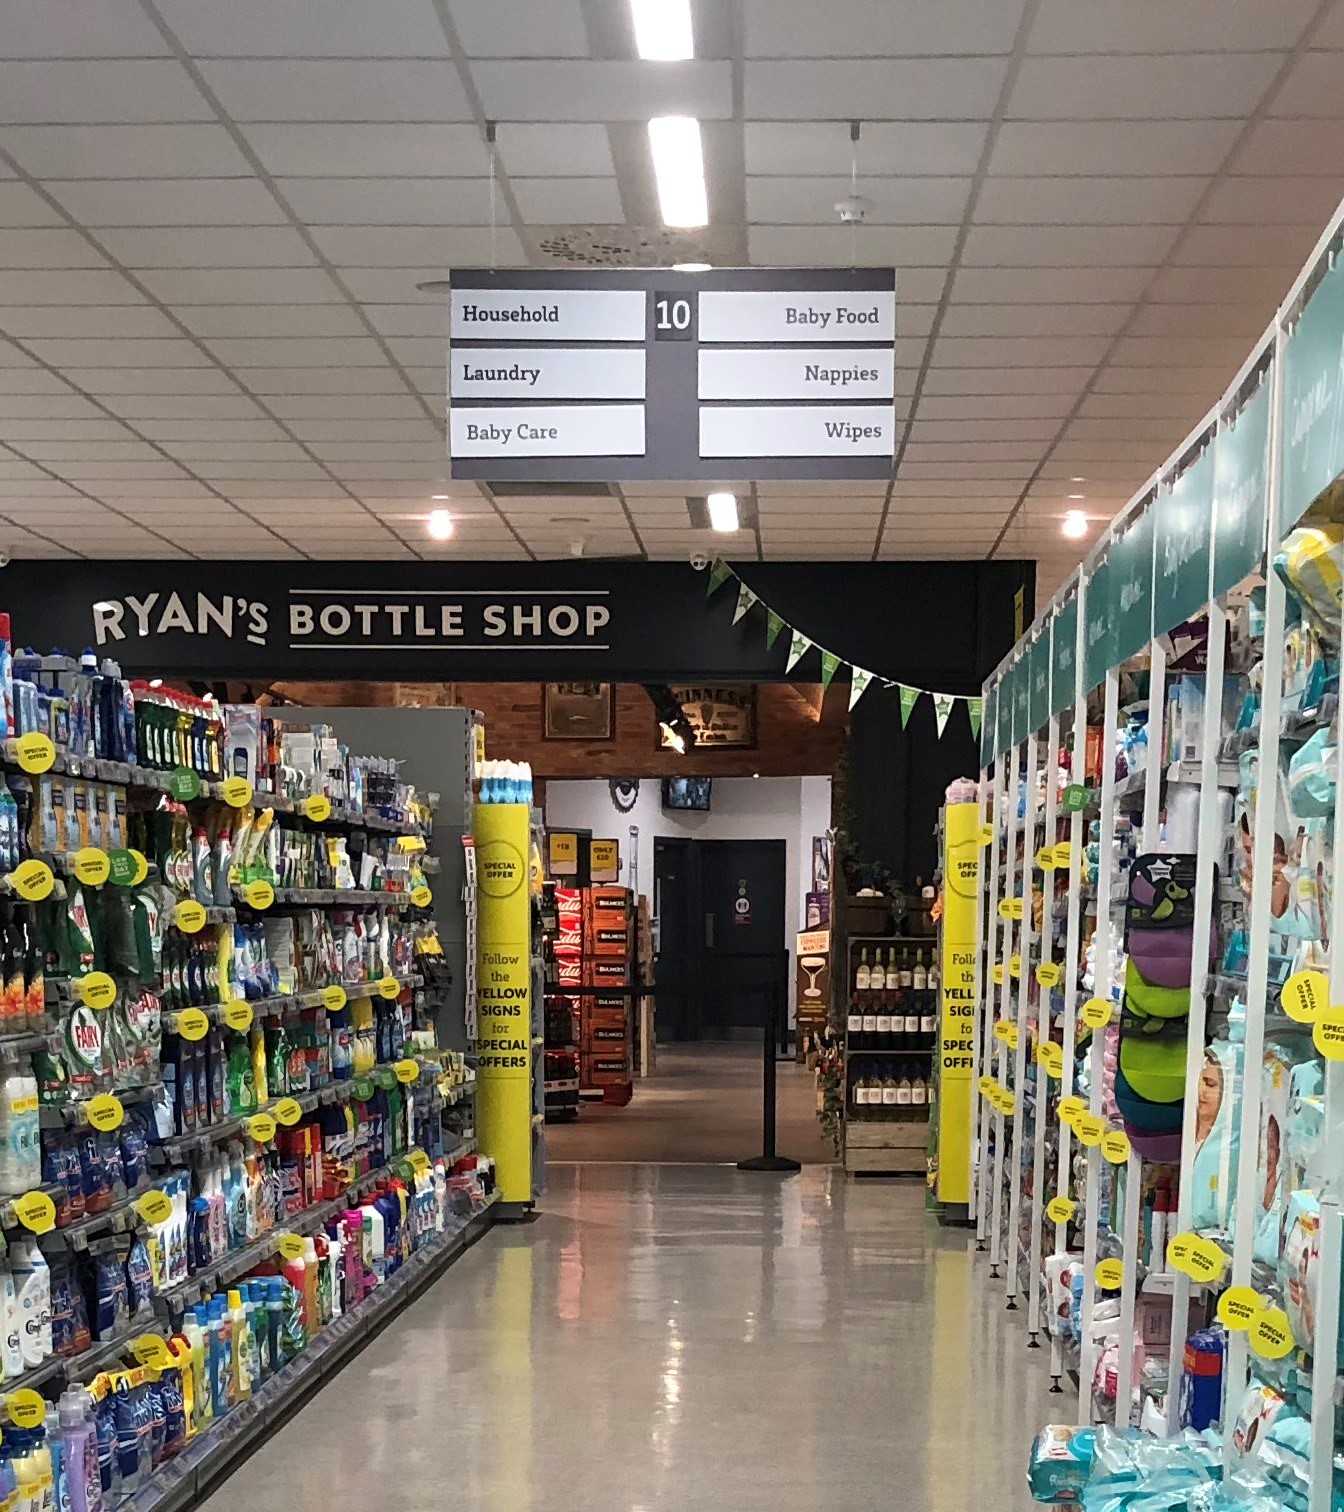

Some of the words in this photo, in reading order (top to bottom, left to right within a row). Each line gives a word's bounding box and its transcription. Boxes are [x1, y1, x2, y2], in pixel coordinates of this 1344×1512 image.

[462, 305, 560, 324] Household
[656, 300, 691, 330] 10
[785, 308, 831, 329] Baby
[836, 308, 880, 325] Food
[463, 364, 541, 387] Laundry
[805, 365, 879, 387] Nappies
[467, 424, 513, 446] Baby
[517, 424, 558, 441] Care
[824, 421, 883, 443] Wipes
[93, 592, 269, 645] RYAN'S
[290, 605, 464, 636] BOTTLE
[483, 605, 611, 637] SHOP
[484, 862, 516, 870] SPECIAL
[482, 953, 519, 965] Follow
[491, 971, 510, 982] the
[477, 988, 527, 999] YELLOW
[481, 1005, 520, 1016] SIGNS
[492, 1023, 509, 1033] for
[477, 1039, 527, 1050] SPECIAL
[479, 1056, 526, 1067] OFFERS
